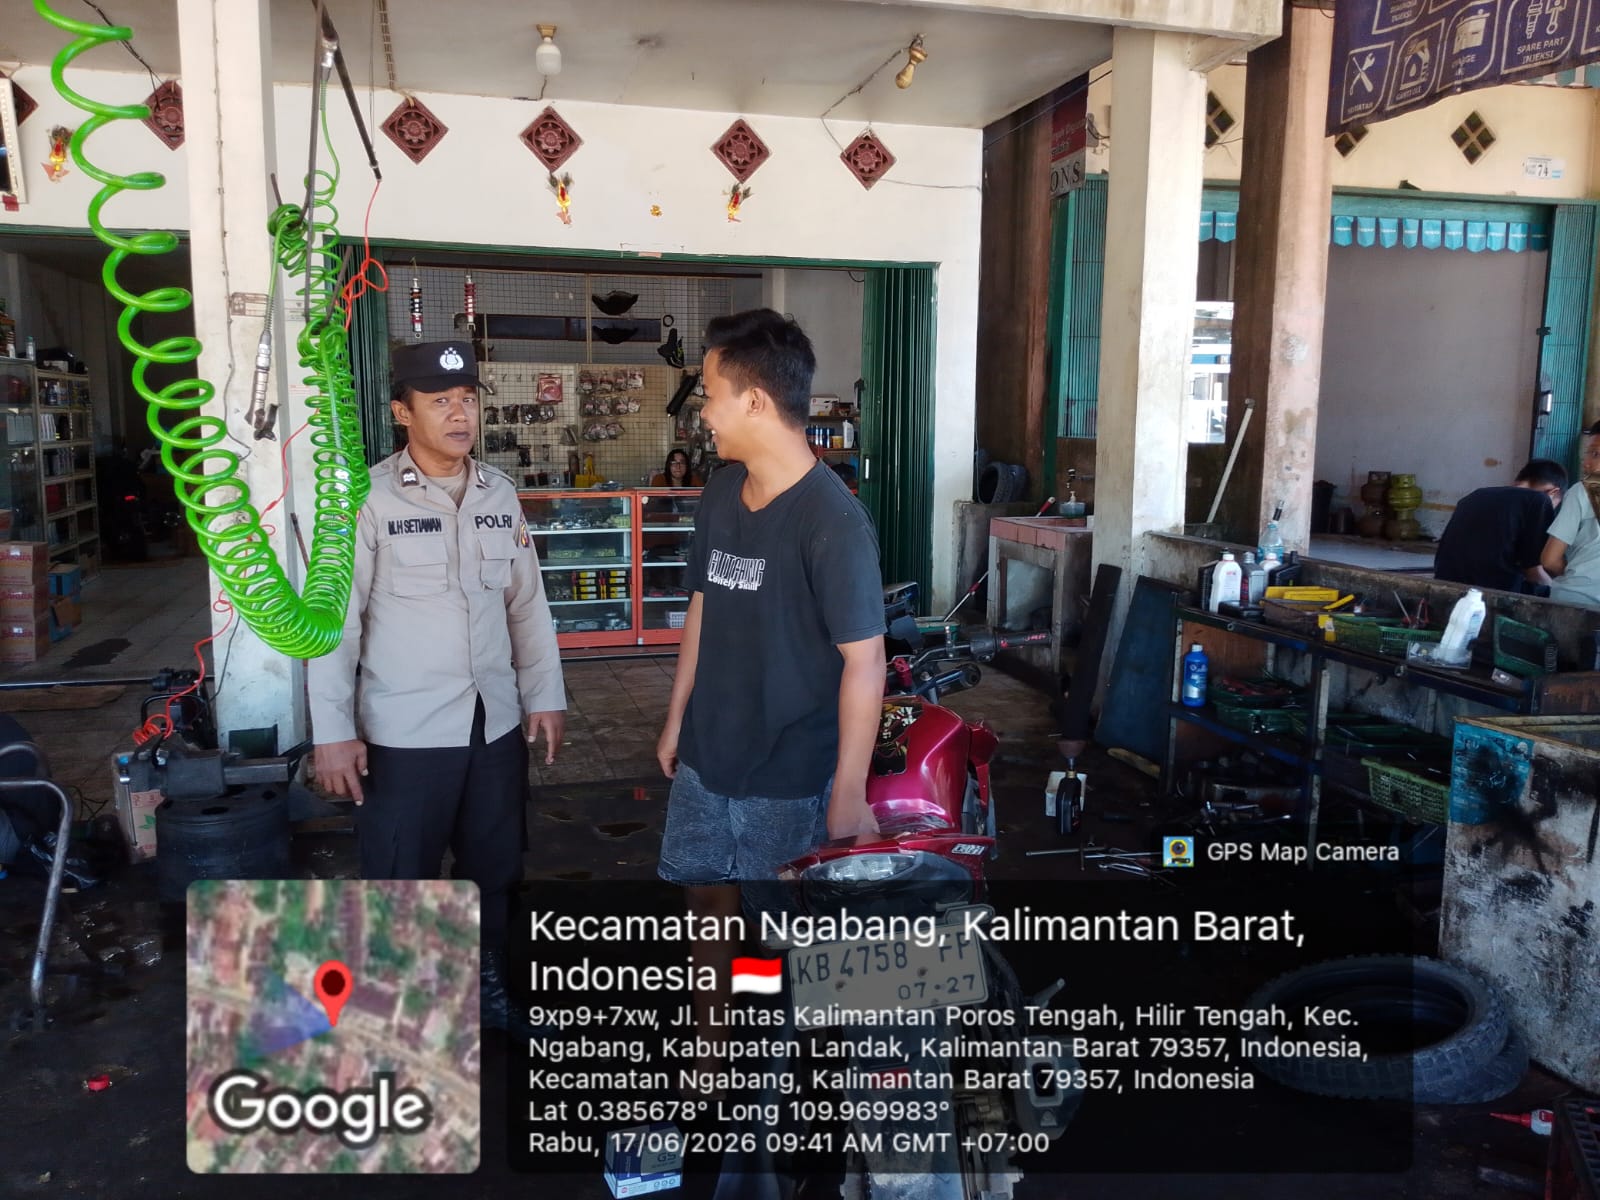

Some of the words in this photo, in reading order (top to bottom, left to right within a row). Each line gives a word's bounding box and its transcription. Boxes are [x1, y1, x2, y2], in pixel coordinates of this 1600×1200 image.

[1517, 41, 1542, 55] SPARE
[1543, 37, 1565, 49] PART
[1522, 50, 1554, 65] INJEKSI
[475, 514, 512, 530] POLRI
[797, 952, 830, 985] KB
[839, 941, 908, 978] 4758
